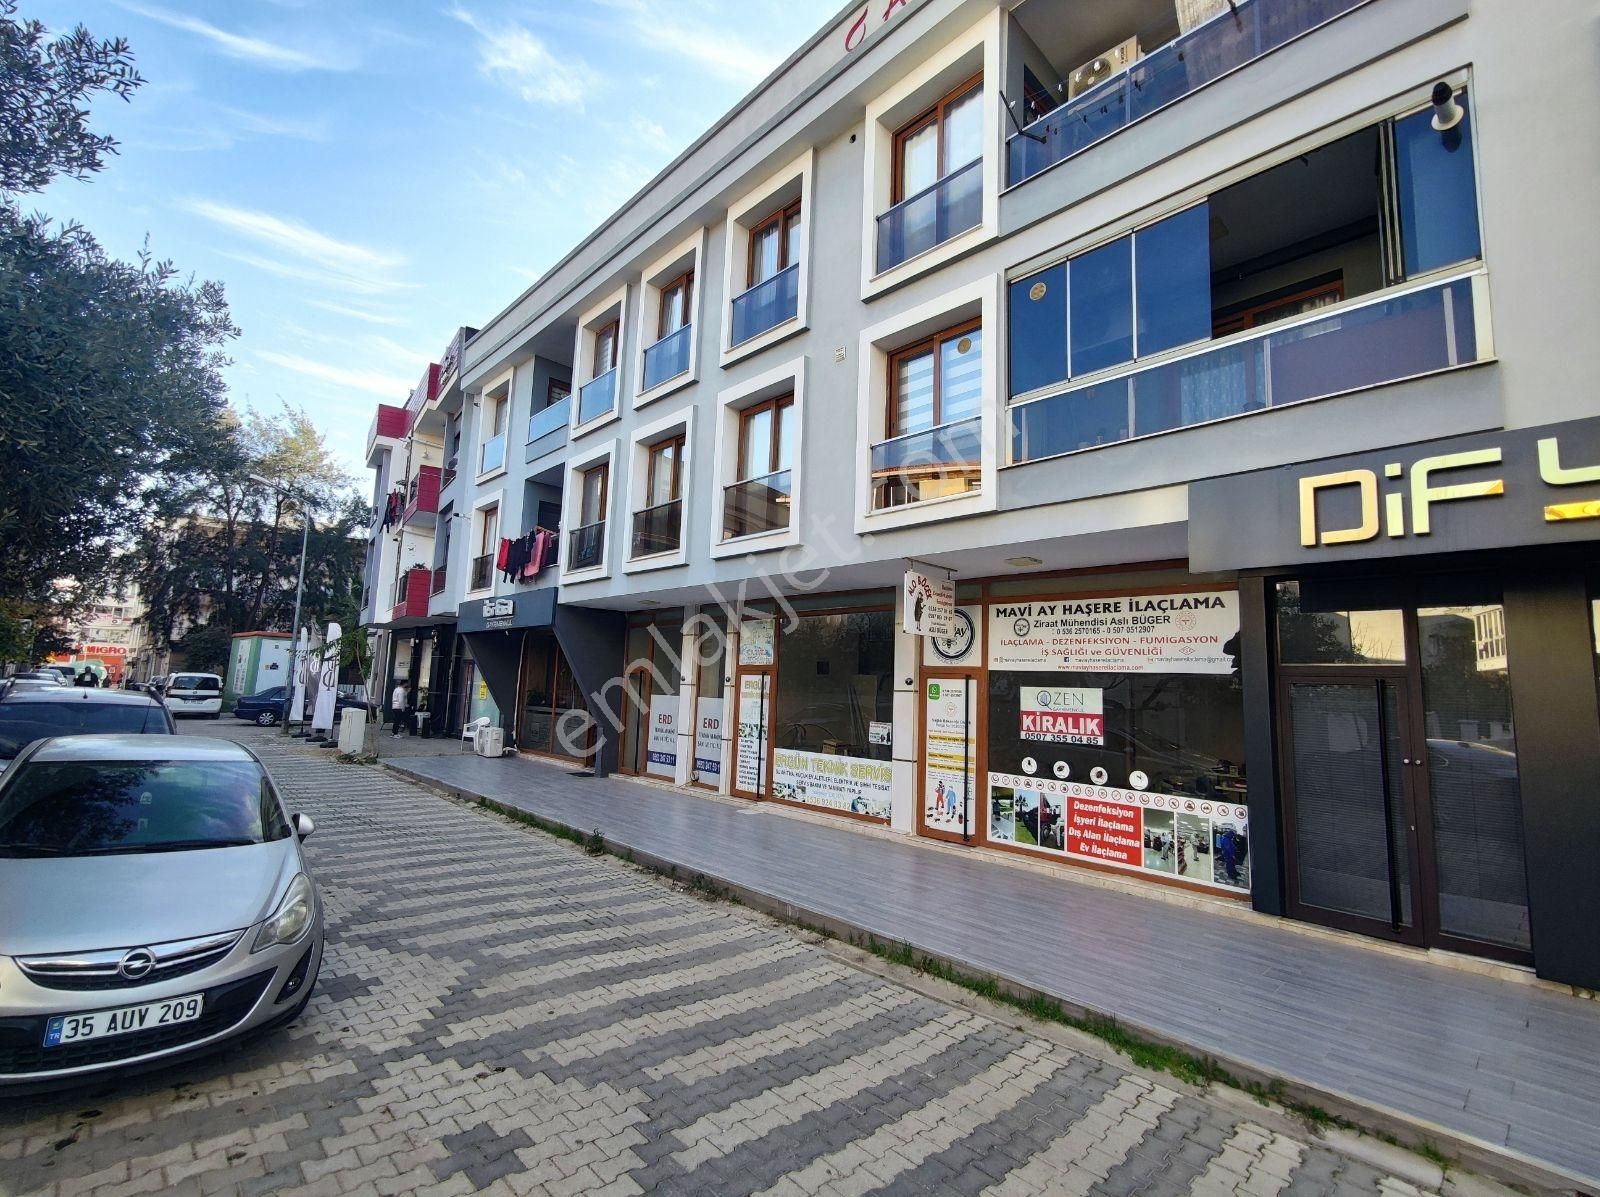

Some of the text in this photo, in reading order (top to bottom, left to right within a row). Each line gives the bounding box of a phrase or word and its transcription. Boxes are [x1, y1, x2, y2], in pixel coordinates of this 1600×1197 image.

[996, 597, 1226, 618] MAVİ AY HAŞERE İLAÇLAMA
[1034, 614, 1170, 628] Ziraat Mühendisi Aslı BÜGER
[1042, 648, 1049, 656] İŞ
[1052, 648, 1088, 656] SAĞLIĞI
[1105, 647, 1162, 656] GÜVENLİĞİ
[658, 714, 672, 724] ERD
[703, 718, 719, 730] ERD
[1022, 712, 1100, 736] KİRALIK
[1025, 732, 1047, 740] 0507
[1050, 734, 1068, 742] 355
[850, 763, 892, 782] SERVİS
[1074, 801, 1134, 818] Dezenfeksiyon
[1074, 812, 1134, 832] İşyeri İlaçlama
[1068, 827, 1140, 848] Dış Alan İlaçlama
[1080, 842, 1127, 859] Ev İlaçlama
[65, 999, 198, 1038] 35 AUV 209
[50, 1032, 60, 1040] TR
